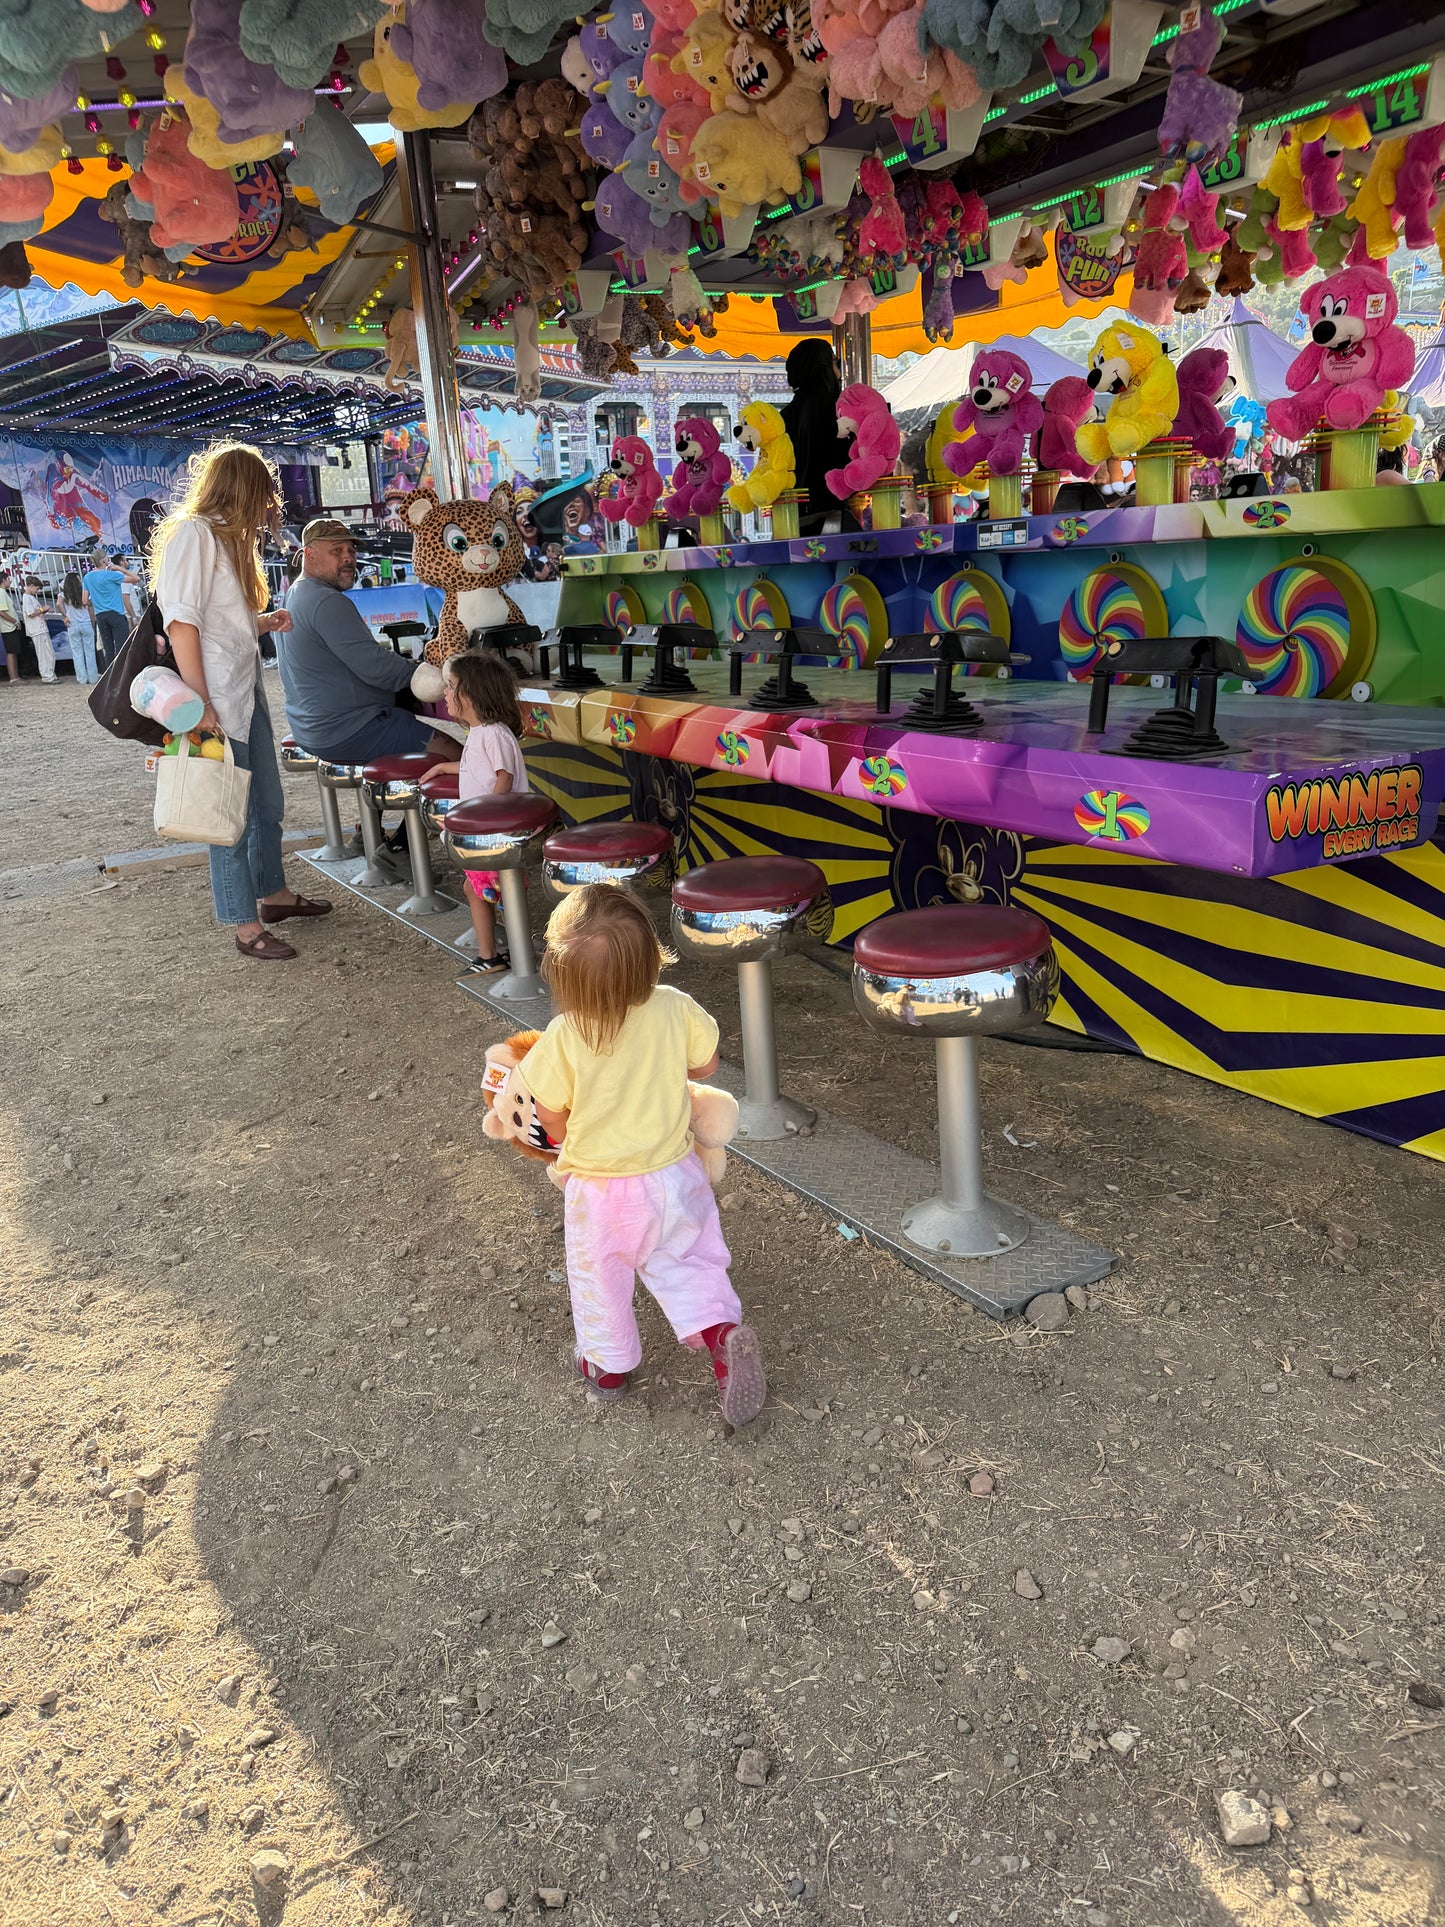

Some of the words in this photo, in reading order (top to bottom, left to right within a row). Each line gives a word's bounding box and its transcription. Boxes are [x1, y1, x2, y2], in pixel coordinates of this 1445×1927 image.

[1066, 35, 1098, 88] 3
[1370, 80, 1420, 132] 14
[911, 105, 941, 157] 4
[1068, 187, 1102, 230] 12
[238, 220, 273, 238] RACE
[561, 281, 578, 314] 8
[873, 269, 894, 294] 10
[112, 464, 174, 492] HIMALAYA
[1063, 518, 1077, 541] 3
[1256, 501, 1275, 528] 2
[616, 712, 627, 743] 4
[725, 734, 738, 765] 3
[873, 759, 891, 795] 2
[1100, 791, 1120, 840] 1
[1266, 768, 1422, 841] WINNER
[1323, 824, 1374, 859] EVERY
[1376, 816, 1419, 846] RACE
